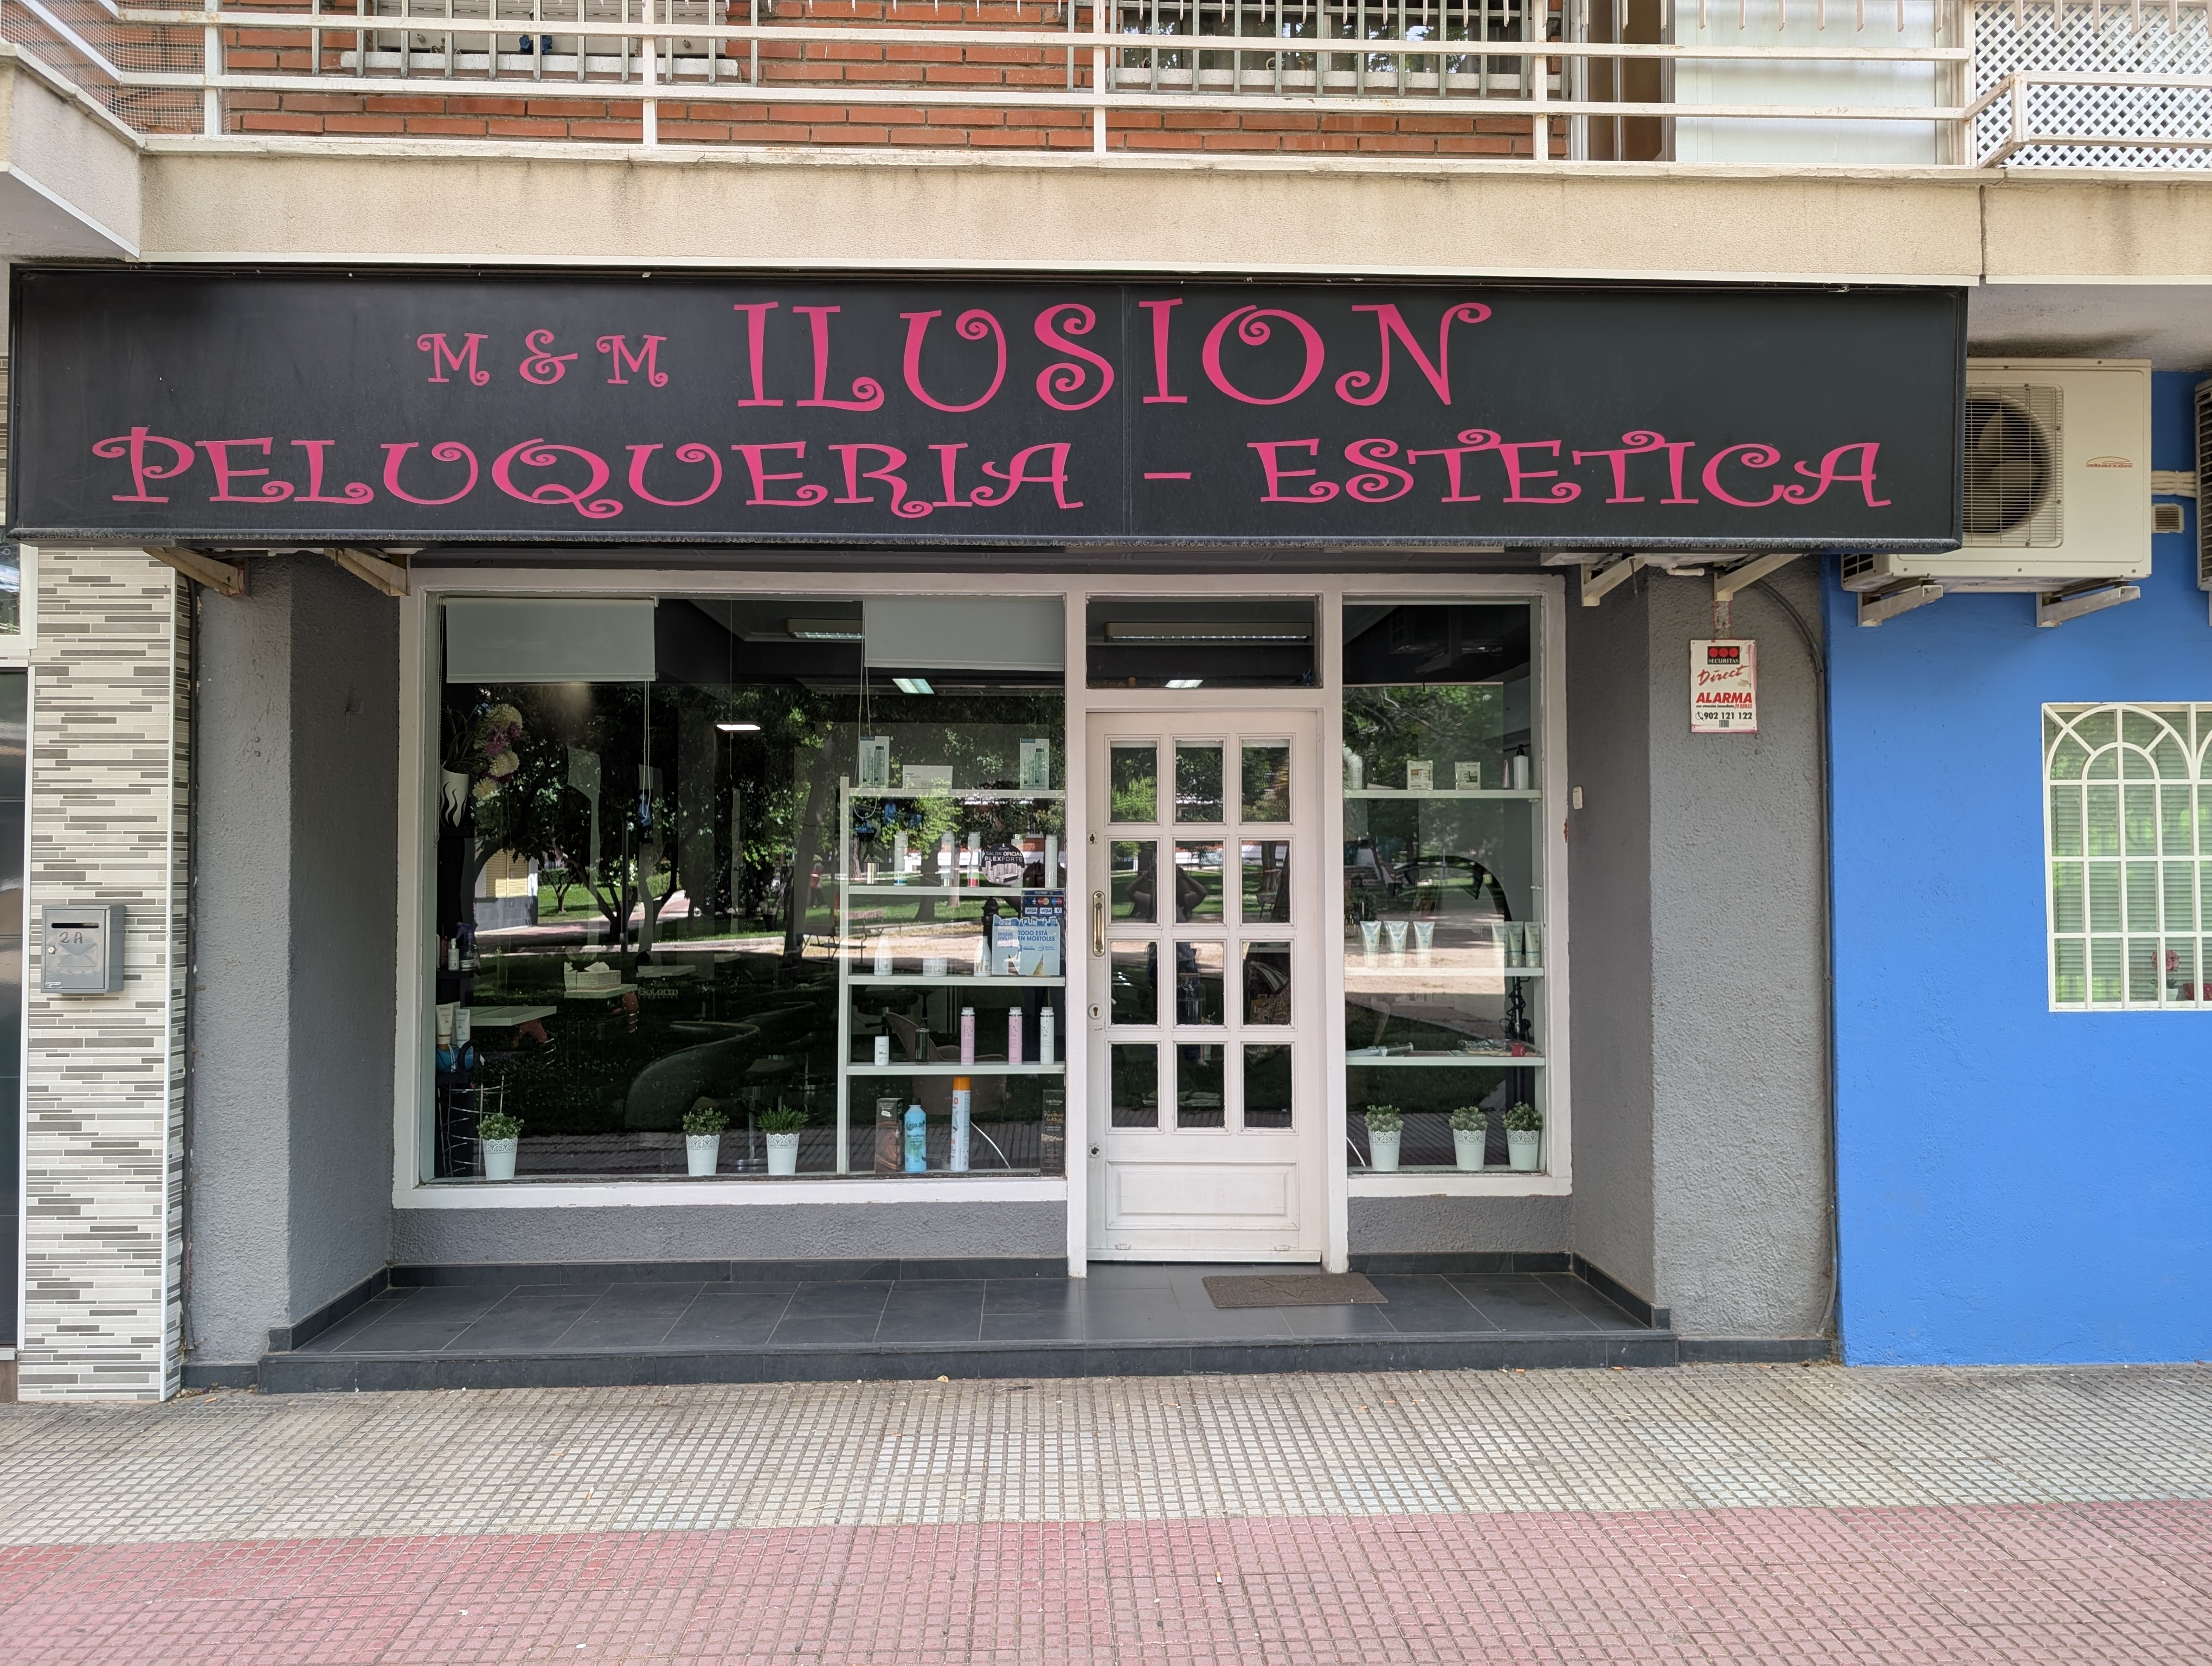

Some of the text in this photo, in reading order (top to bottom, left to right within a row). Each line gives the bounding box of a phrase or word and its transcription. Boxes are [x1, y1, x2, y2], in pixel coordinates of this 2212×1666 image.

[417, 298, 1492, 413] M & M ILUSION
[92, 426, 1084, 519] PELUQUERIA
[1246, 428, 1892, 508] ESTETICA
[1695, 693, 1752, 703] ALARMA
[1697, 664, 1748, 686] Direct
